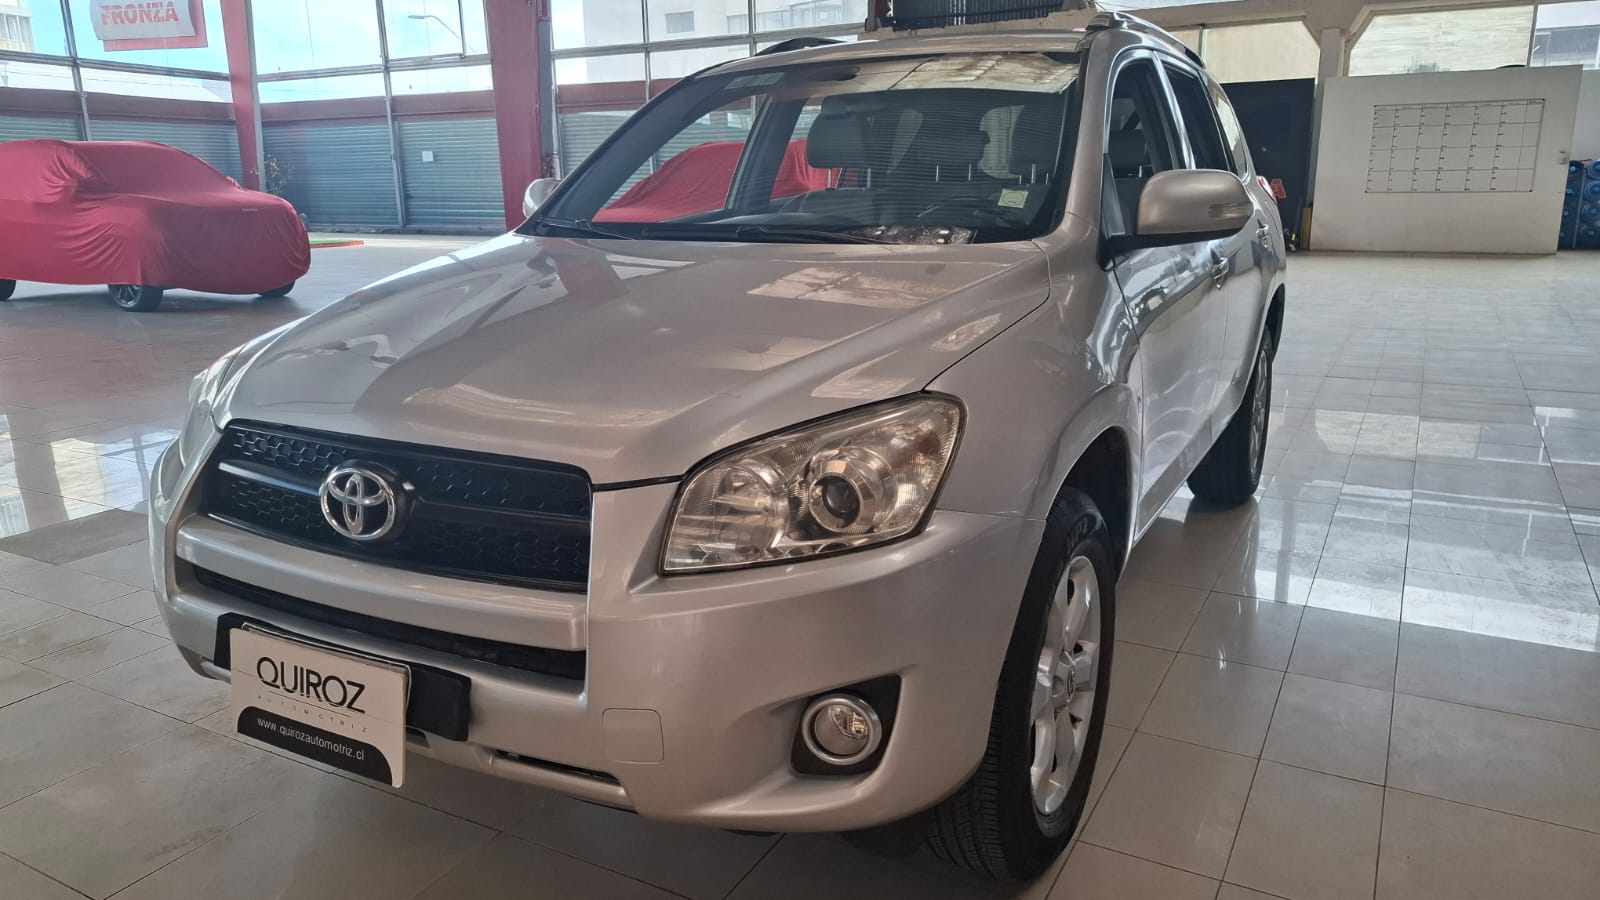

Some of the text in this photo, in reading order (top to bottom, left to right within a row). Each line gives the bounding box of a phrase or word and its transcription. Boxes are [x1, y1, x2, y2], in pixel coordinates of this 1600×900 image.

[100, 1, 180, 25] FRONZA
[256, 656, 366, 715] QUIROZ
[257, 717, 366, 761] www.quirozautomotriz.cl
